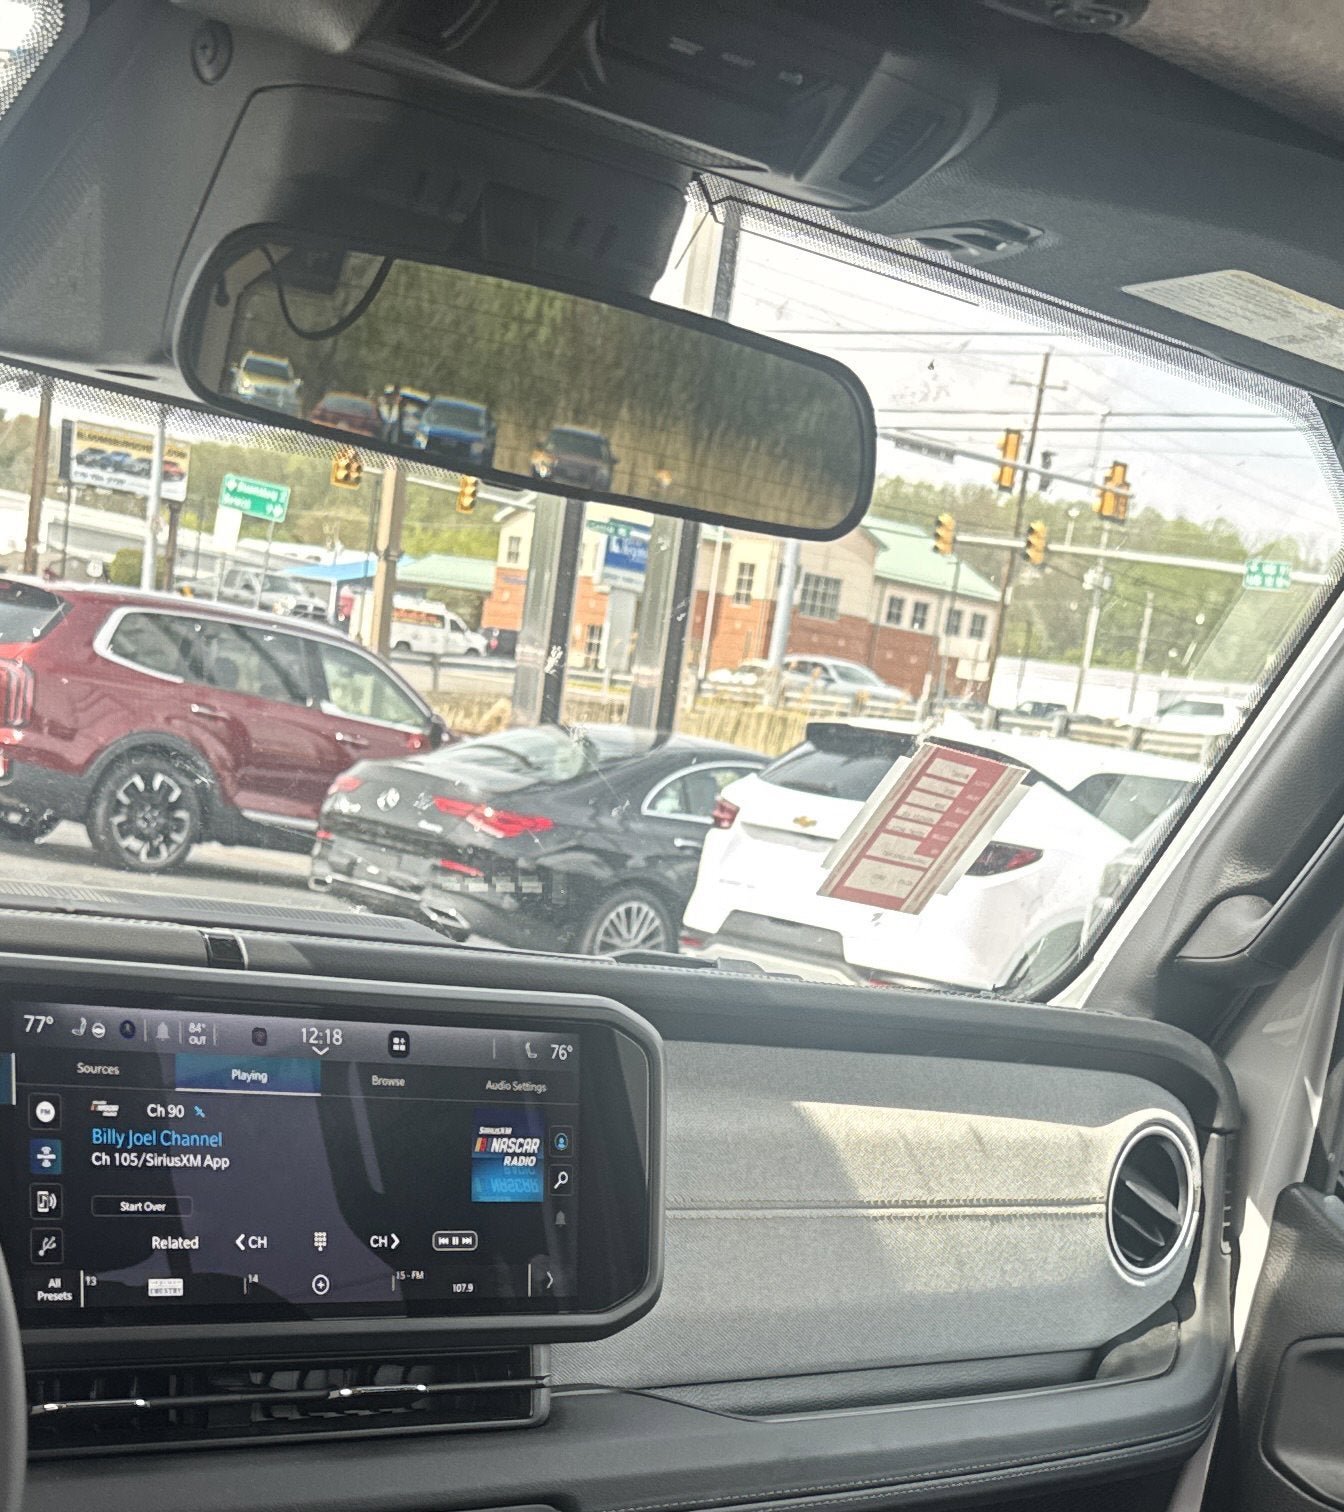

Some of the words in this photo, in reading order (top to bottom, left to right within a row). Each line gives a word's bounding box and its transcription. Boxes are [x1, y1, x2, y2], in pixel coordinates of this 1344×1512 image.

[23, 1014, 54, 1034] 77°
[188, 1035, 206, 1046] OUT
[301, 1027, 343, 1045] 12:18
[550, 1044, 573, 1061] 76°
[76, 1063, 120, 1076] Sources
[231, 1068, 268, 1084] Playing
[371, 1075, 406, 1087] Browse
[485, 1080, 511, 1091] Audio
[512, 1080, 547, 1094] Settings
[146, 1103, 165, 1118] Ch
[167, 1104, 184, 1118] 90
[91, 1128, 126, 1148] Billy
[127, 1130, 157, 1148] Joel
[159, 1130, 222, 1147] Channel
[490, 1137, 540, 1154] NASCAR
[91, 1152, 111, 1166] Ch
[114, 1152, 202, 1168] 105/SiriusXM
[203, 1155, 230, 1170] App
[503, 1155, 536, 1167] RADIO
[120, 1201, 142, 1212] Start
[144, 1201, 167, 1212] Over
[151, 1236, 200, 1250] Related
[248, 1236, 268, 1249] CH
[369, 1235, 388, 1248] CH
[48, 1278, 61, 1288] All
[85, 1276, 97, 1286] 13
[248, 1274, 259, 1284] 14
[452, 1283, 474, 1293] 107.9
[37, 1290, 73, 1302] Presets
